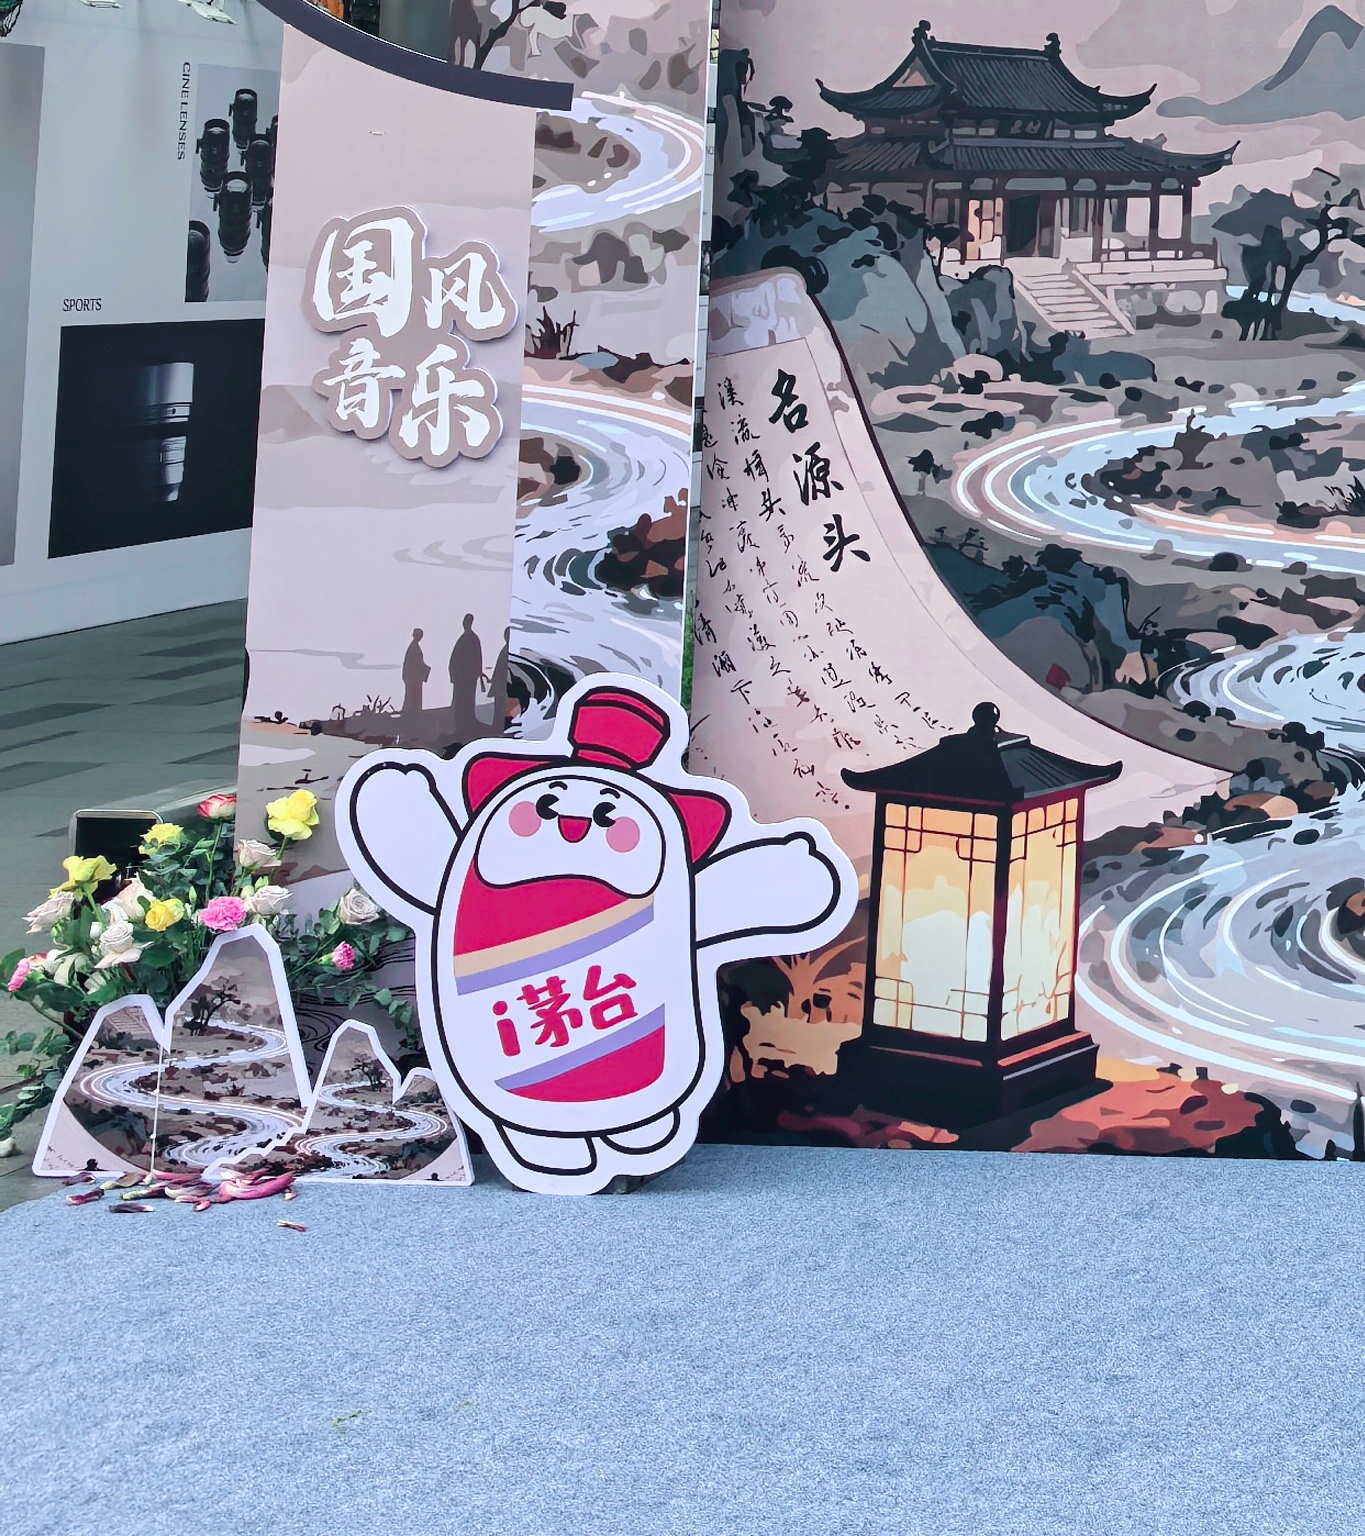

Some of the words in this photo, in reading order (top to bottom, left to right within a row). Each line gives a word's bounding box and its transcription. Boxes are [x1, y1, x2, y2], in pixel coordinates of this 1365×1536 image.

[181, 61, 191, 99] CINE
[177, 102, 188, 161] LENSES
[62, 298, 103, 312] SPORTS
[313, 217, 506, 337] 国风
[323, 337, 491, 456] 音乐
[492, 965, 638, 1057] i茅台
